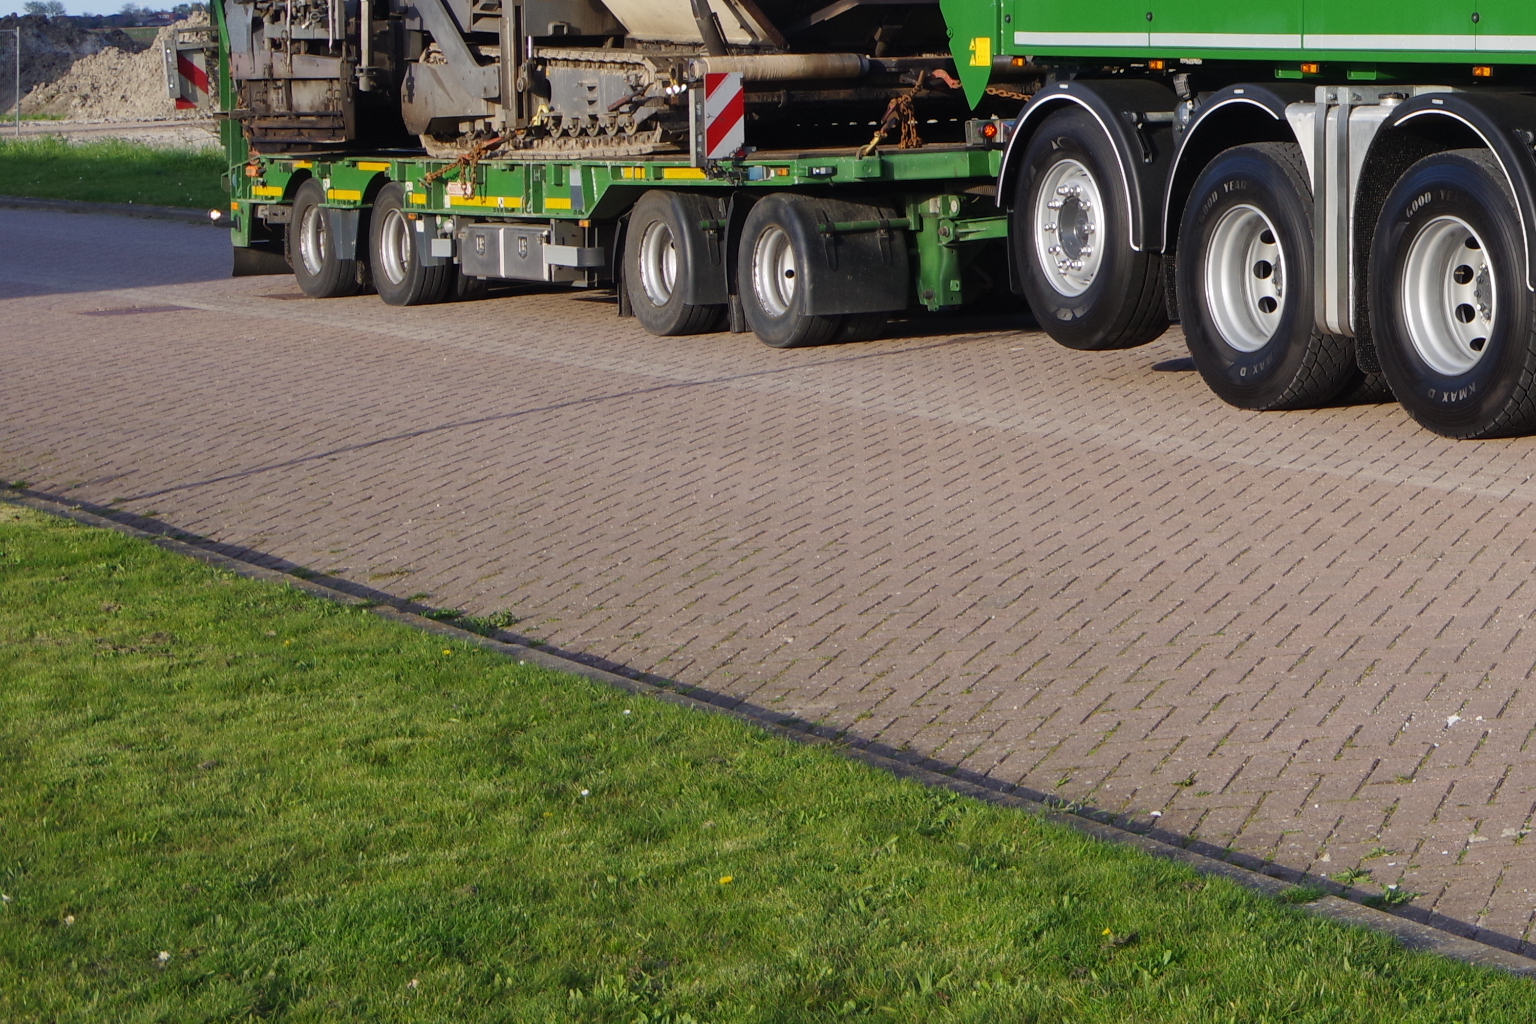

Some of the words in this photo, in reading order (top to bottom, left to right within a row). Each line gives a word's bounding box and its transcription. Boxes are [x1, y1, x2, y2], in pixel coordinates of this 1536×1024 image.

[1198, 190, 1218, 224] GOOD
[1223, 180, 1247, 193] YEAR
[1405, 191, 1432, 218] GOOD
[1428, 388, 1436, 399] D
[1441, 381, 1476, 403] KMAX
